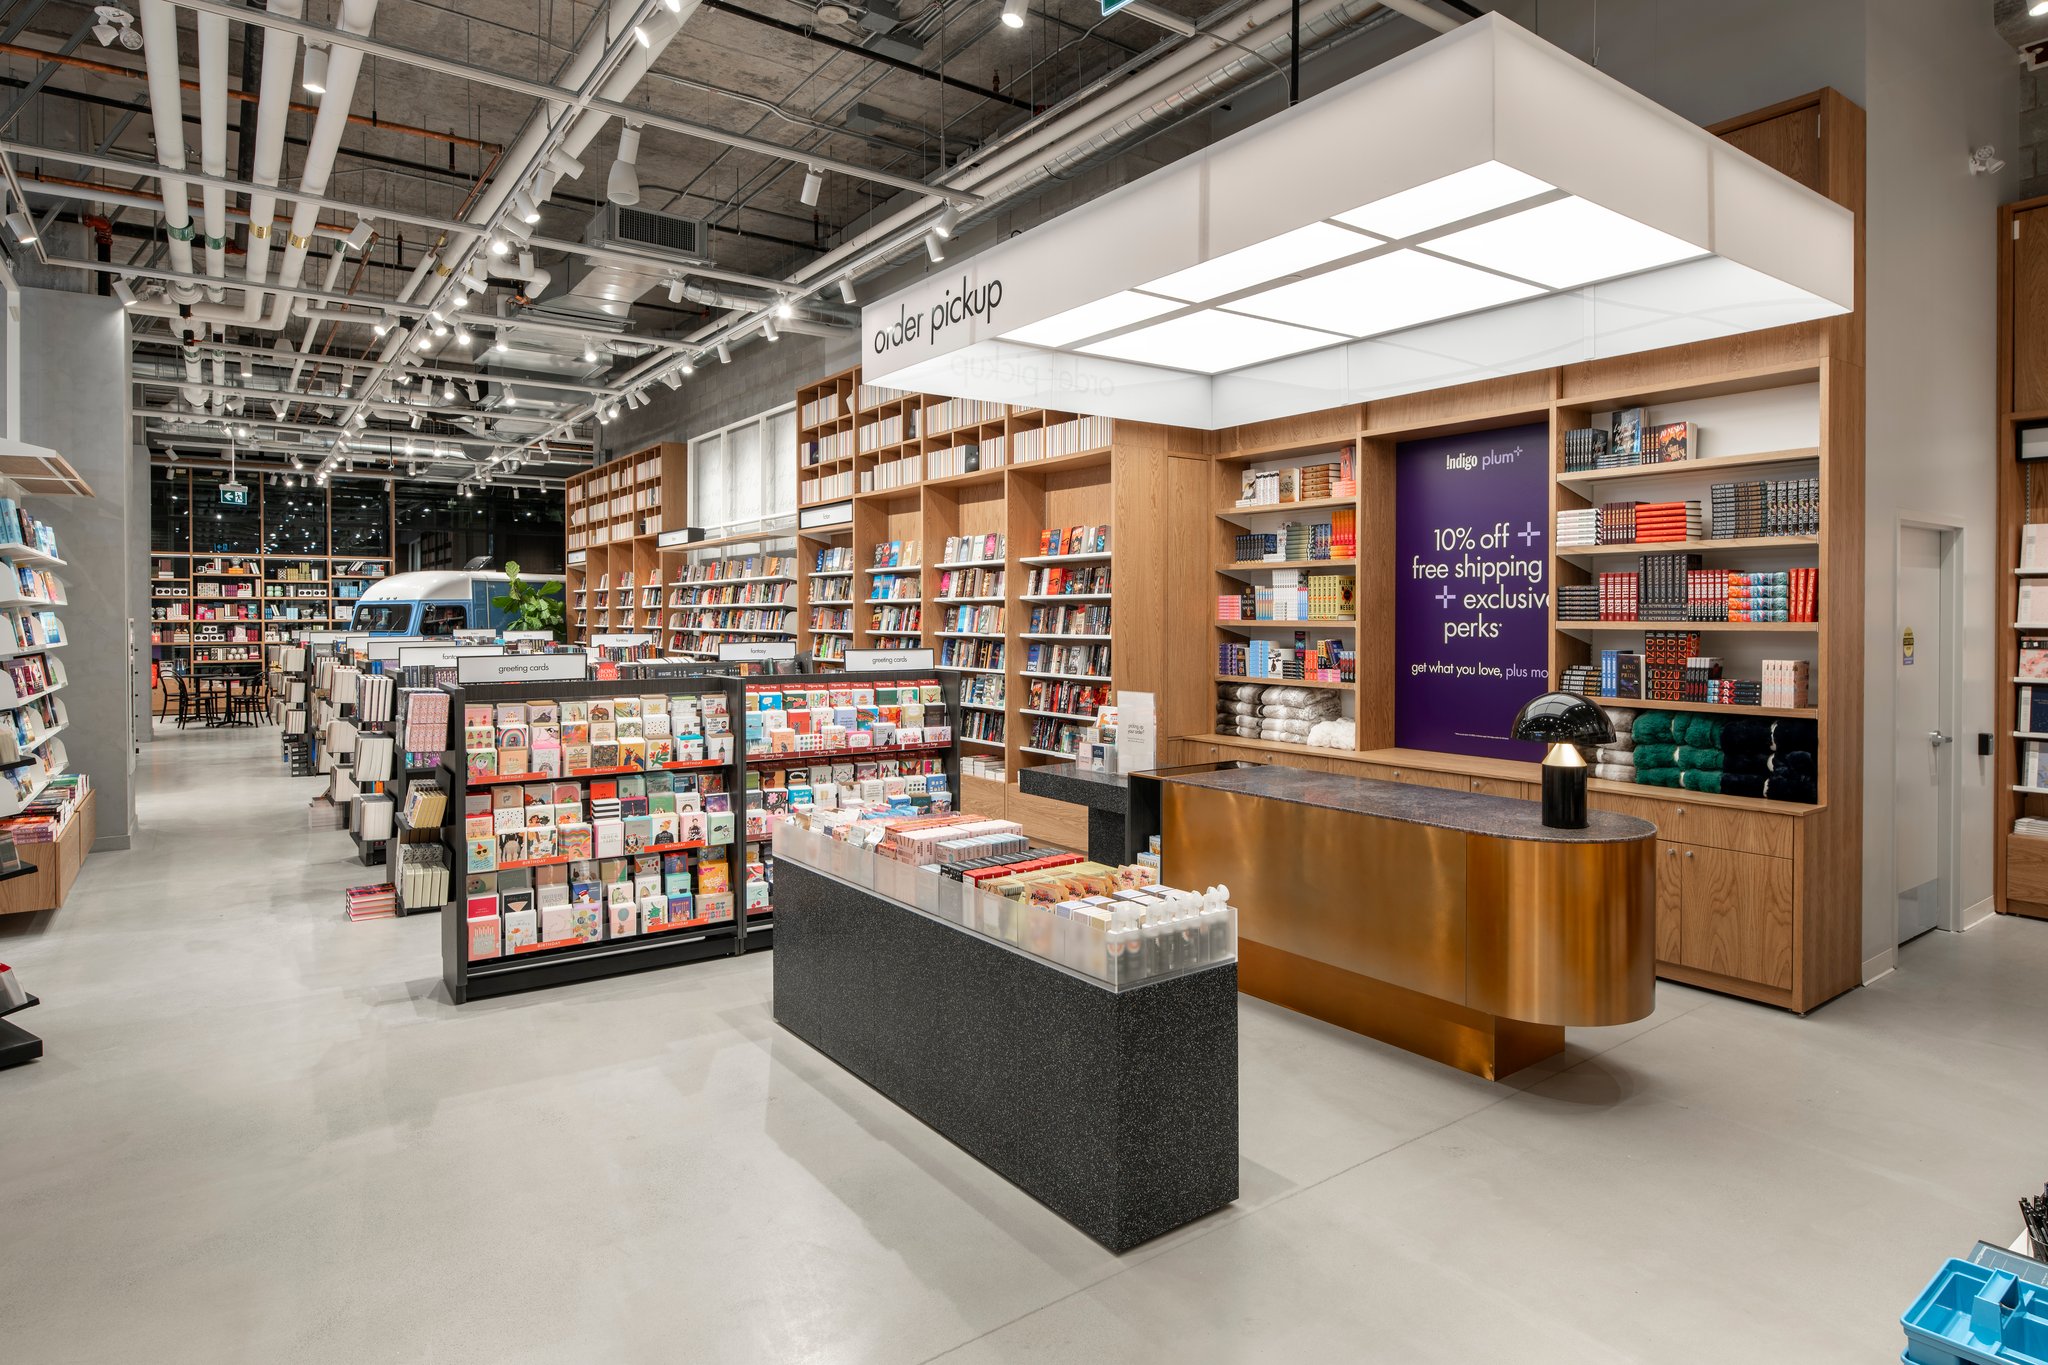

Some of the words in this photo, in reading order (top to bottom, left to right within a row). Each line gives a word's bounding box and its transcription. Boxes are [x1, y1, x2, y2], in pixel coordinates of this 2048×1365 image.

[874, 303, 924, 354] order
[931, 276, 1003, 346] pickup
[1434, 526, 1476, 551] 10%
[1480, 522, 1510, 549] off
[1412, 555, 1449, 579] free
[1454, 553, 1542, 584] shipping
[499, 665, 528, 674] greeting
[530, 663, 549, 671] cards
[1411, 662, 1427, 676] get
[1428, 661, 1454, 674] what
[1456, 665, 1476, 678] you
[1478, 662, 1503, 678] love,
[1505, 664, 1528, 680] plus
[1530, 668, 1548, 678] mo
